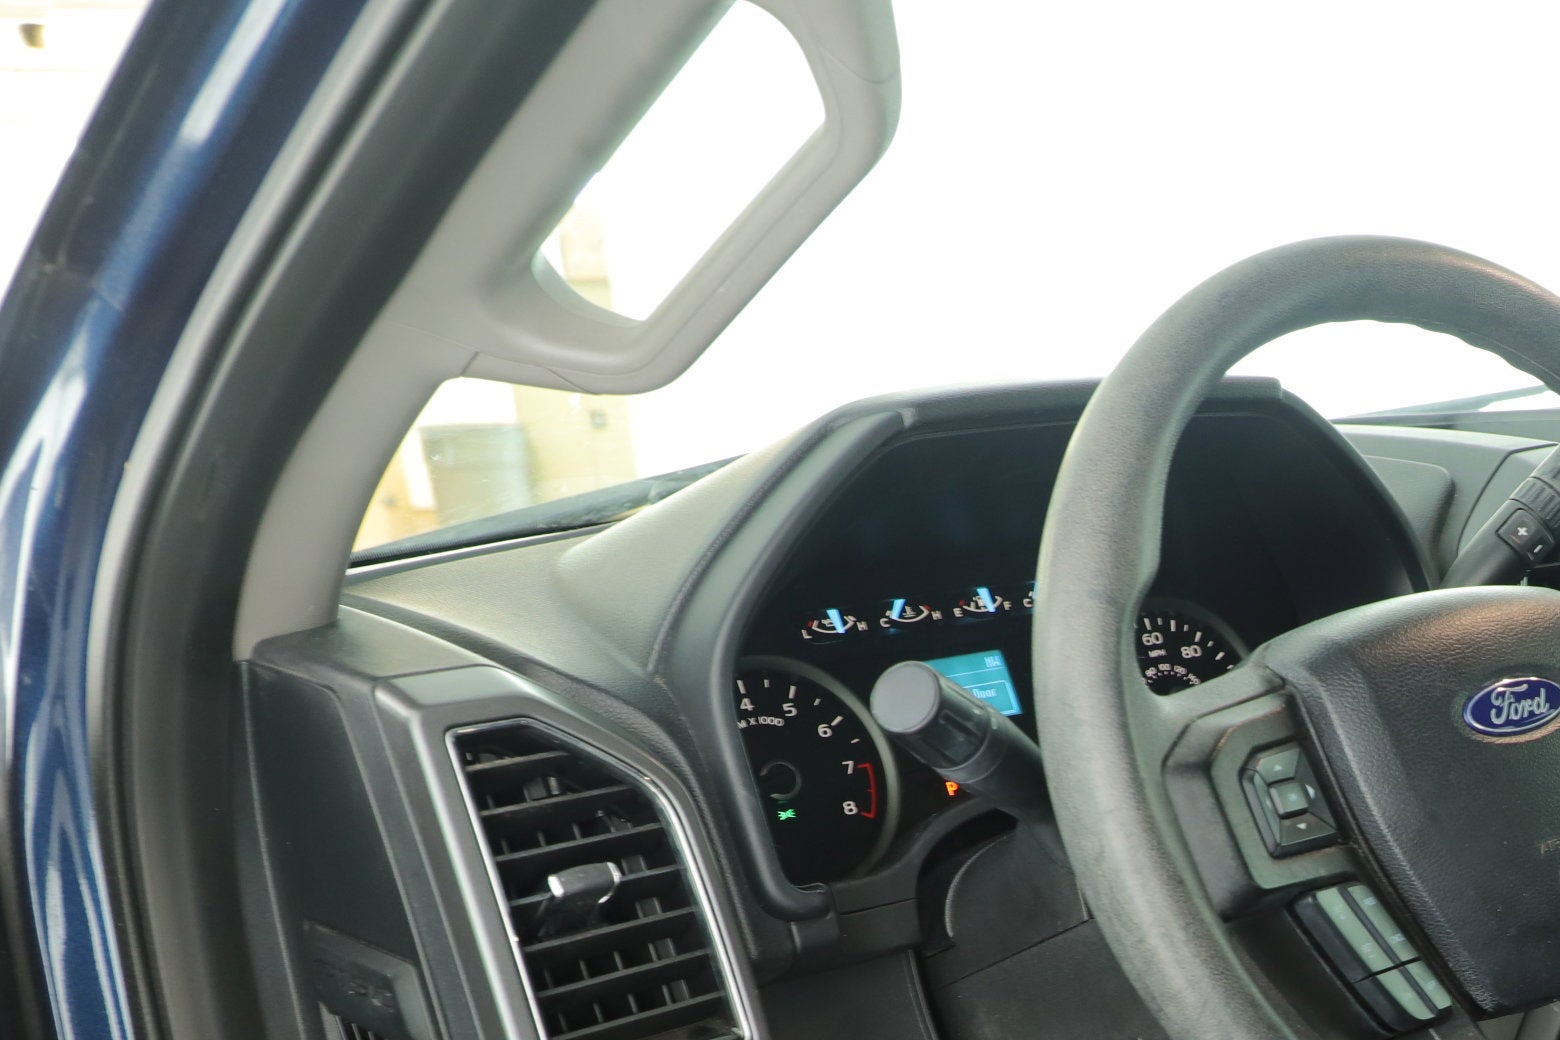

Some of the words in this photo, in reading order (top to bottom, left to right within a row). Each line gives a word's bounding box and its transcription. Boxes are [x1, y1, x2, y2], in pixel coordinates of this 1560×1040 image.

[931, 609, 943, 621] H
[953, 607, 965, 618] E
[856, 620, 869, 632] H
[879, 617, 891, 628] C
[1141, 631, 1164, 646] 60
[1180, 644, 1202, 659] 80
[740, 697, 755, 711] 4
[782, 702, 798, 717] 5
[1489, 683, 1551, 725] Ford
[757, 716, 785, 727] 1000
[817, 723, 833, 738] 6
[841, 760, 855, 775] 7
[945, 781, 959, 796] P
[842, 800, 858, 815] 8
